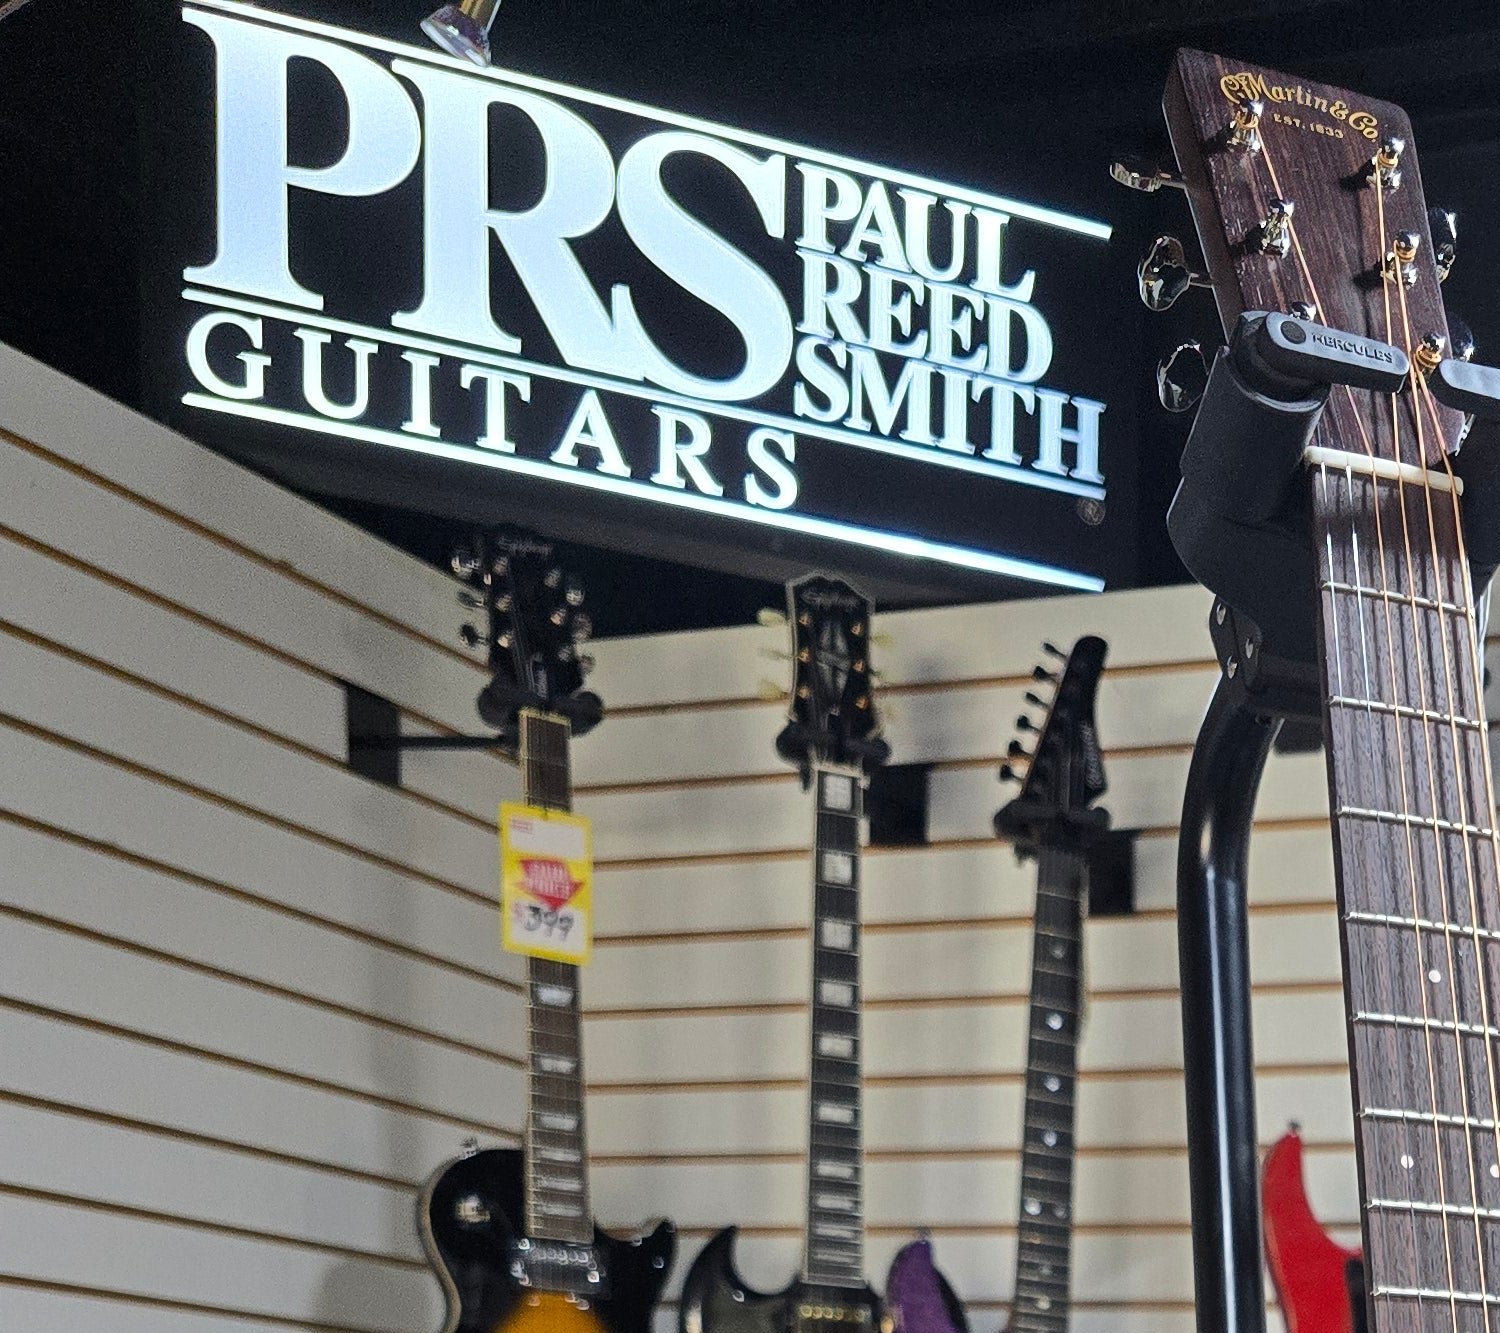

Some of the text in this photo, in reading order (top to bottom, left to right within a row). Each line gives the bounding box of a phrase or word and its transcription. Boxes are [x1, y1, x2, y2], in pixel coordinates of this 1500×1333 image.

[182, 7, 794, 402] PRS
[796, 161, 1036, 304] PAUL
[796, 248, 1053, 386] REED
[1311, 332, 1393, 364] HERCULES
[185, 311, 799, 512] GUITARS
[794, 334, 1106, 487] SMITH
